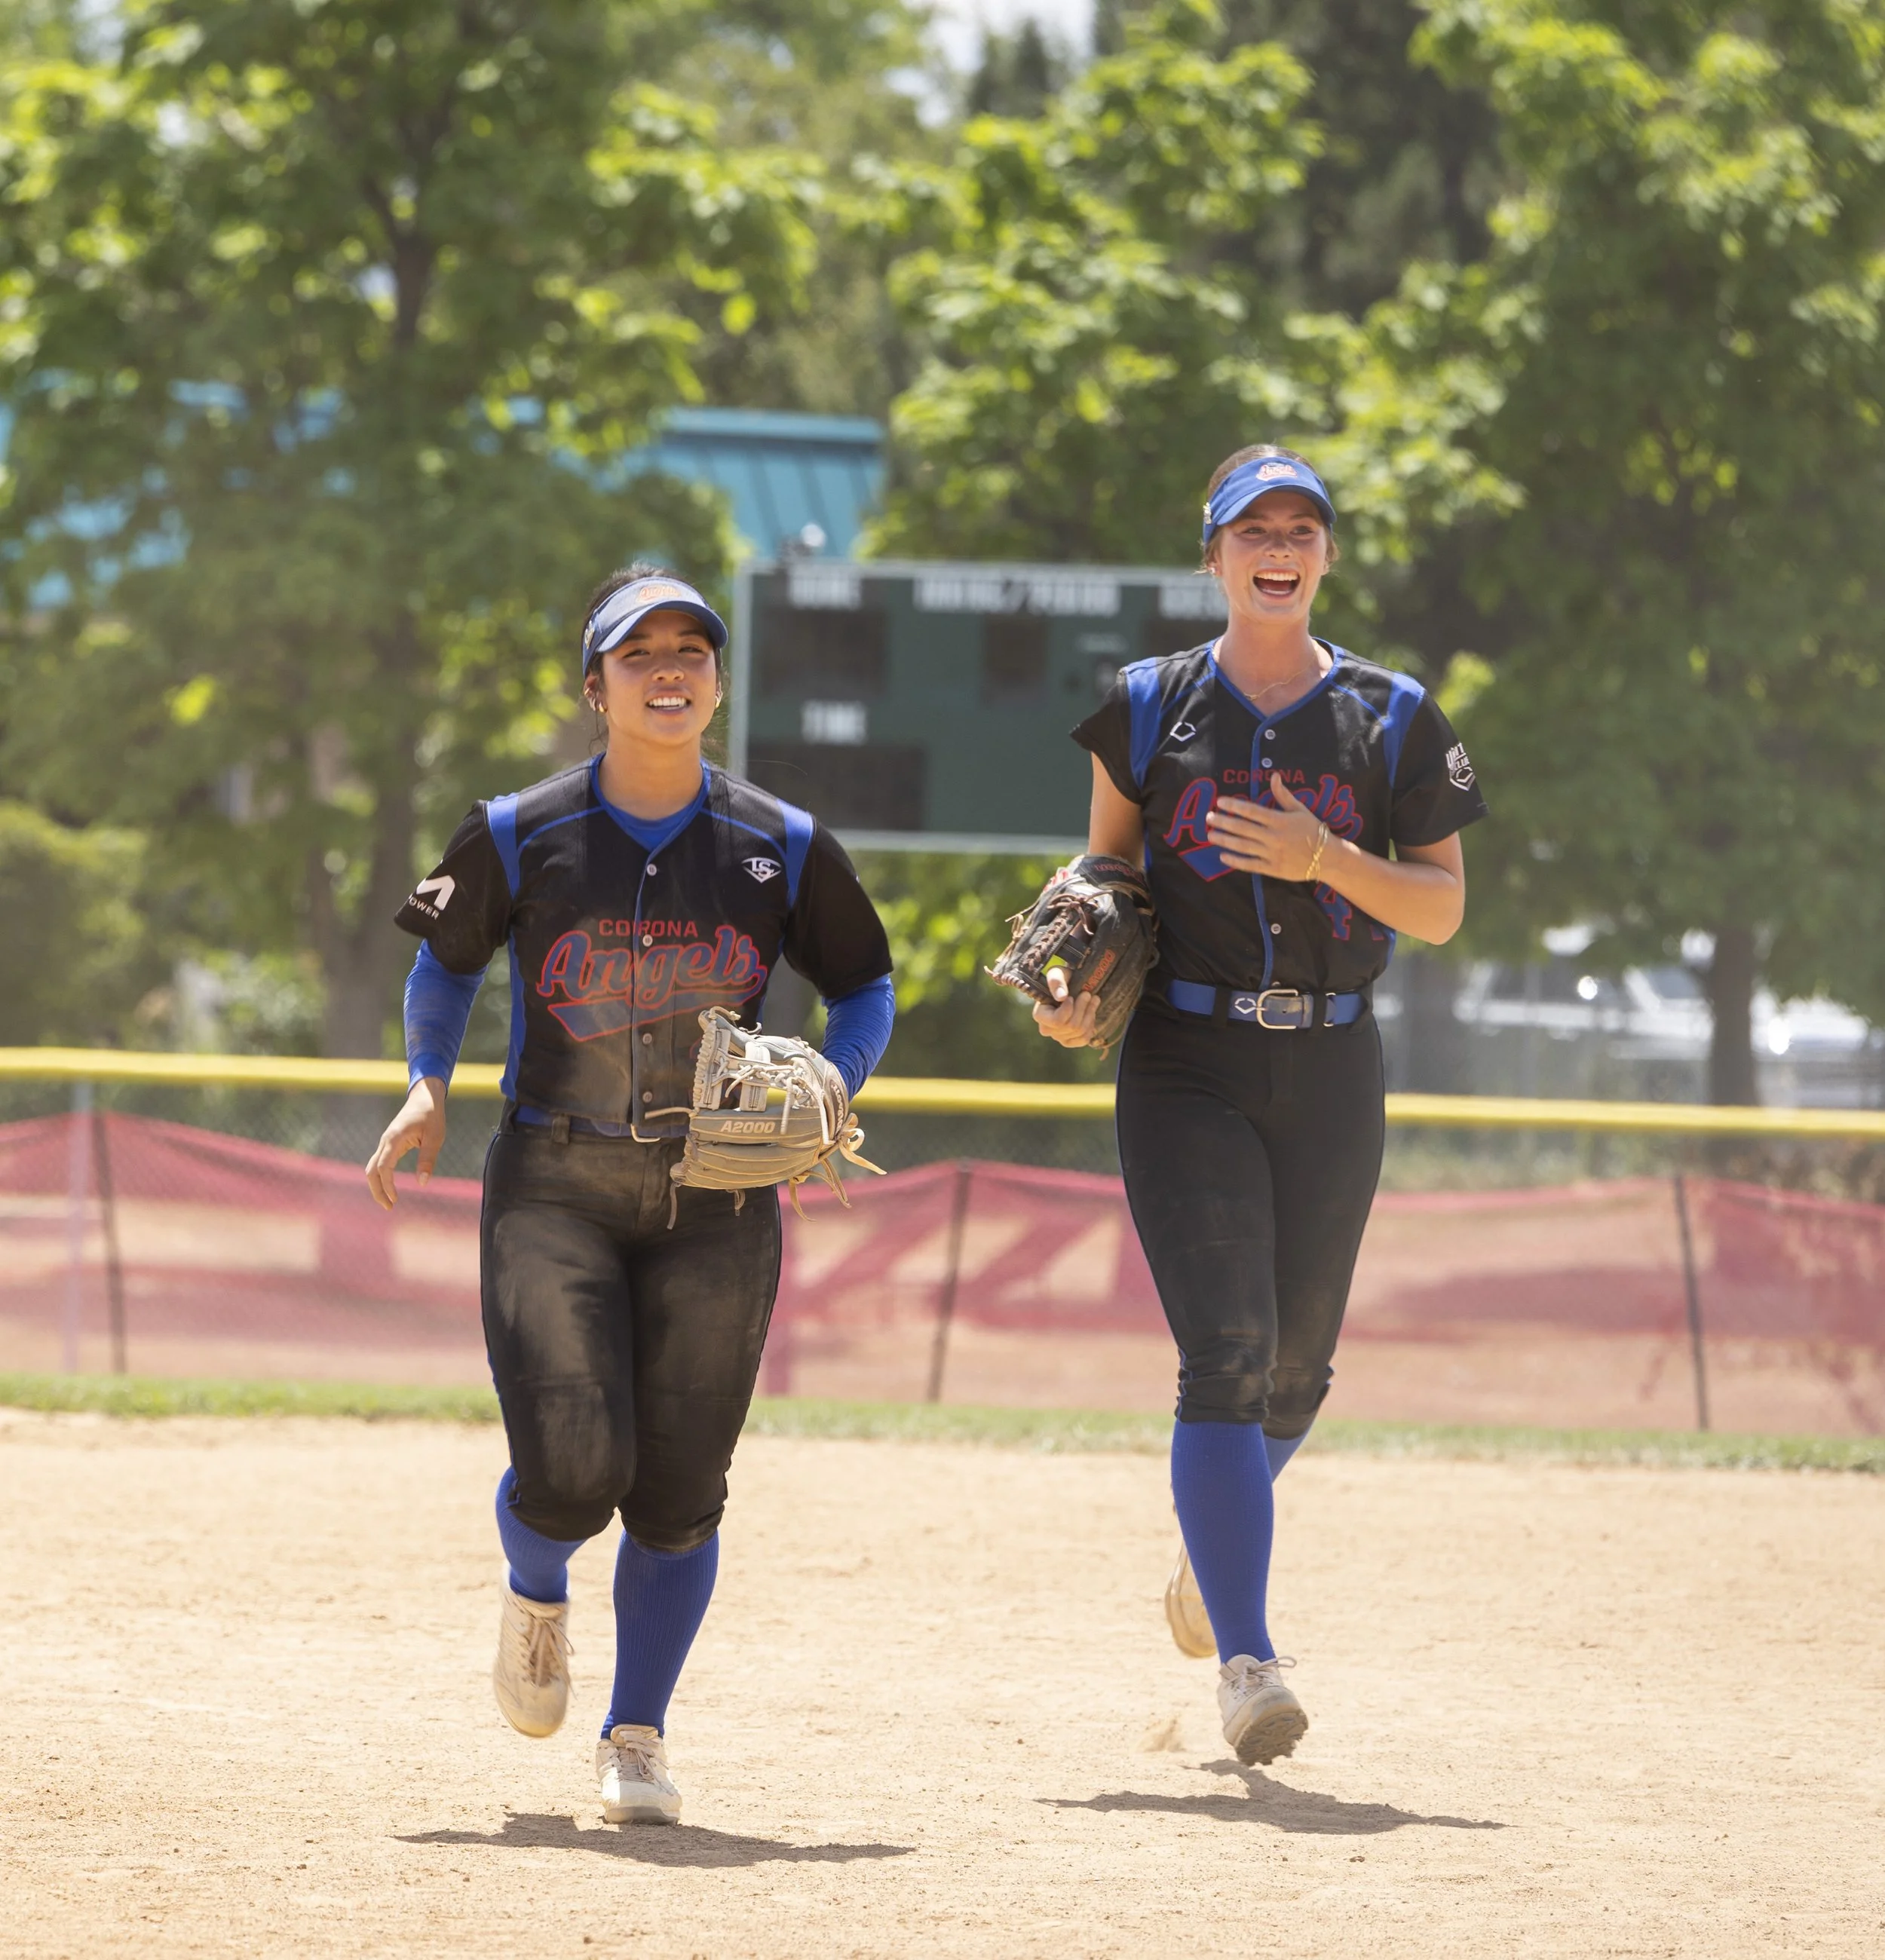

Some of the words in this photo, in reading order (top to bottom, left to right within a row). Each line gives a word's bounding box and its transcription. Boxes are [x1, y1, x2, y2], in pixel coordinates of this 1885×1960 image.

[408, 894, 440, 920] OWER
[599, 918, 698, 938] CORONA
[535, 924, 768, 1010] Angels
[720, 1119, 776, 1133] A2000
